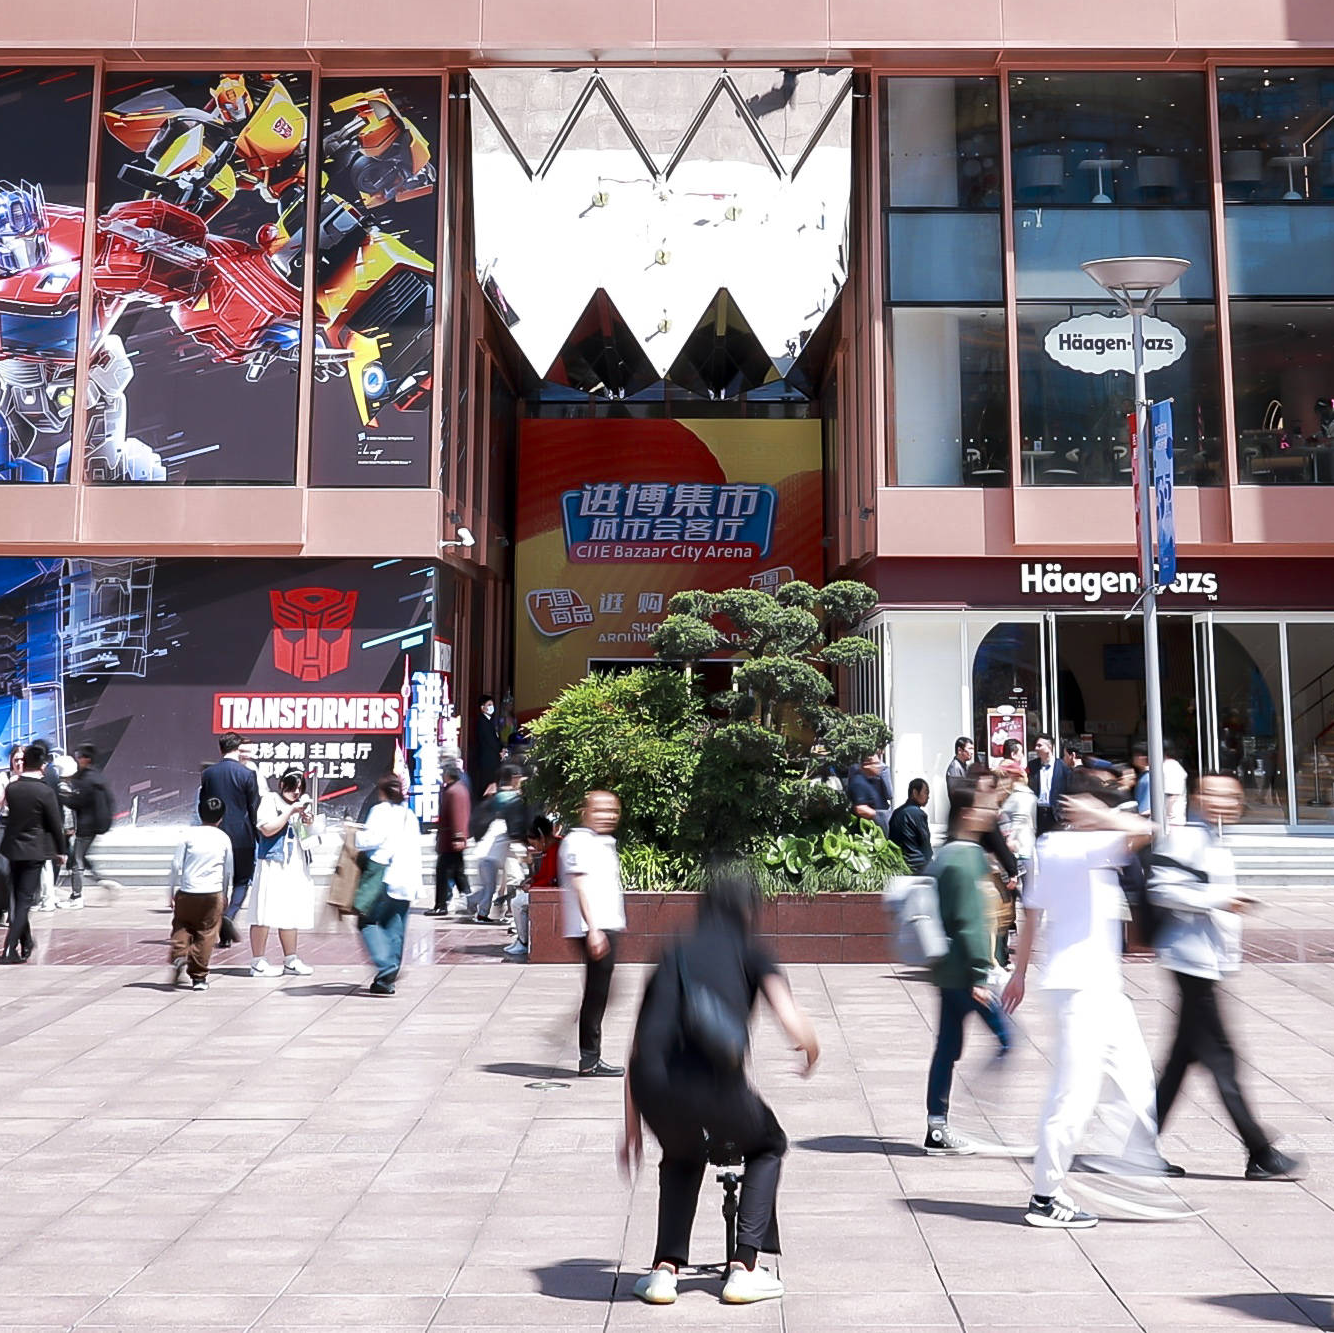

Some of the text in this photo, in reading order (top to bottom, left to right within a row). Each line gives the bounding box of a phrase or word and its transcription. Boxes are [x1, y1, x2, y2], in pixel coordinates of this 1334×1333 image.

[580, 483, 761, 517] 进博集市
[588, 518, 748, 541] 城市会客厅
[576, 545, 753, 562] CIIE Bazaar City Arena
[536, 589, 573, 609] 万国
[551, 606, 594, 625] 商品
[631, 622, 662, 633] SHO
[598, 633, 649, 643] AROUN
[219, 697, 400, 729] TRANSFORMERS
